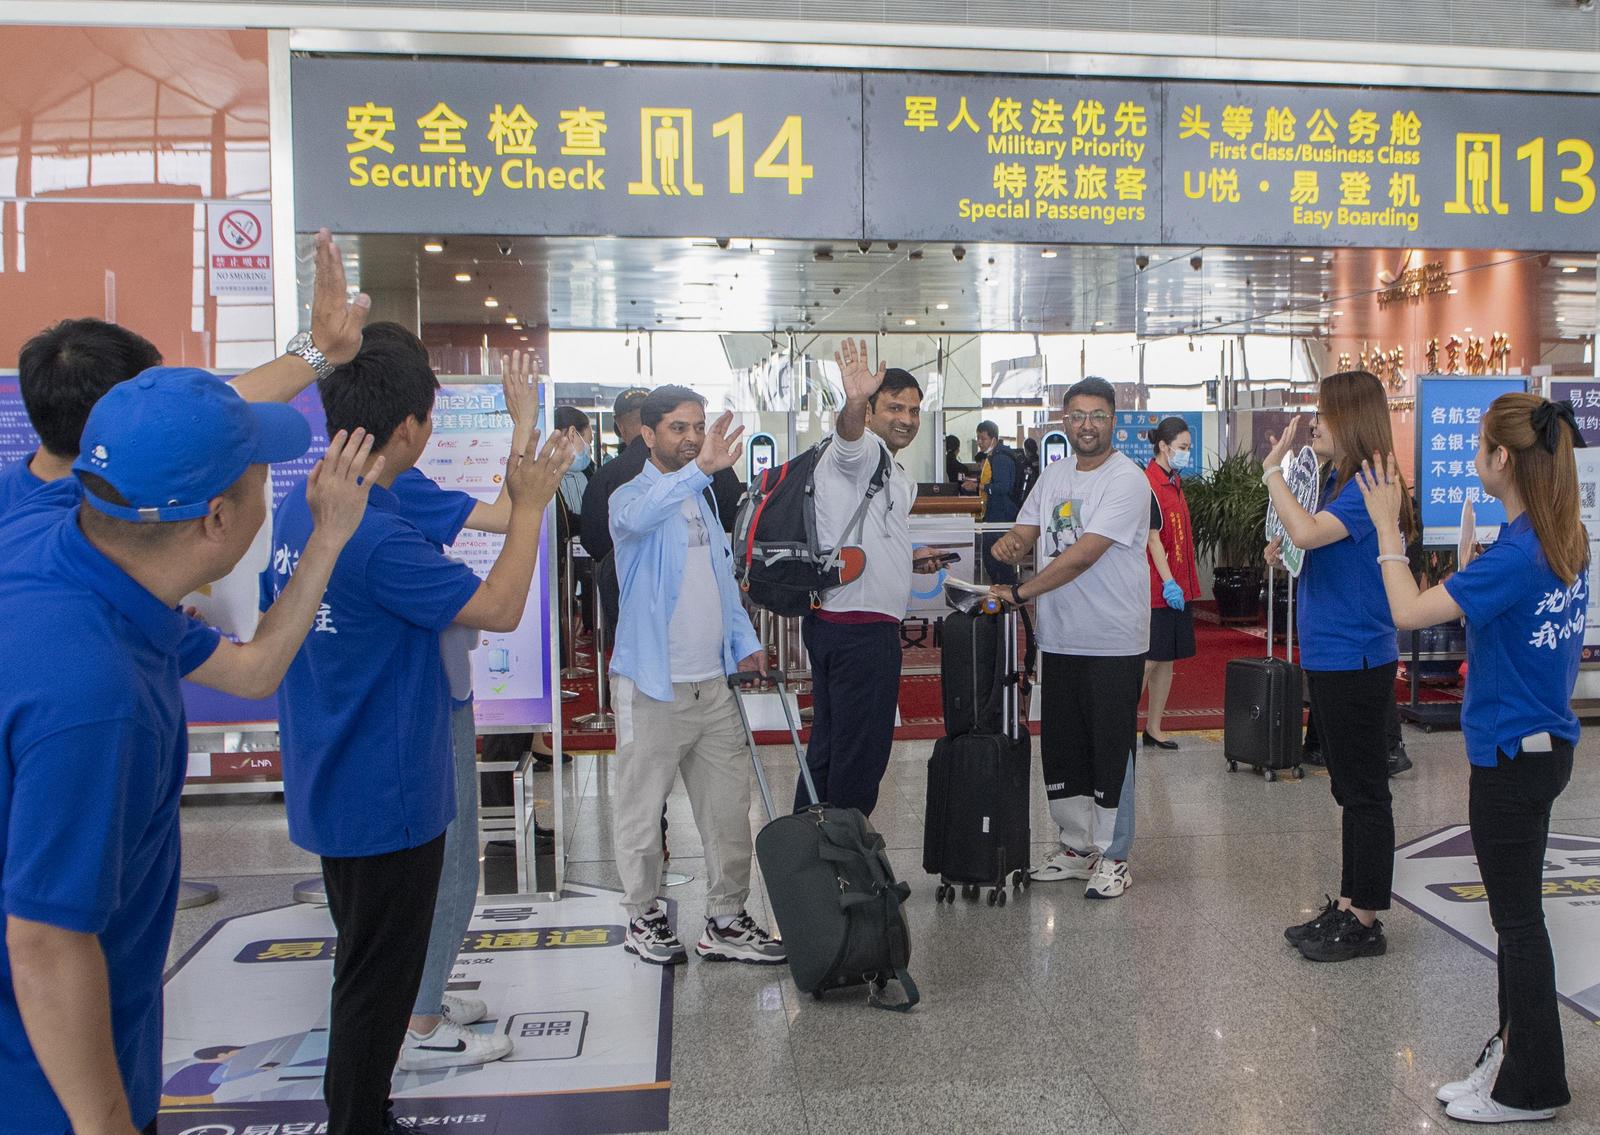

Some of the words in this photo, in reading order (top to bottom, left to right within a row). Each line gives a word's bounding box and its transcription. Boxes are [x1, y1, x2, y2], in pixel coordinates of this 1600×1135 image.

[346, 102, 608, 156] 安全检查
[904, 96, 1148, 138] 军人依法优先
[1178, 105, 1421, 147] 头等舱公务舱
[712, 112, 815, 195] 14
[987, 134, 1066, 158] Military
[1071, 137, 1146, 162] Priority
[1209, 141, 1247, 162] First
[1250, 143, 1375, 165] Class/Business
[1376, 145, 1421, 165] Class
[349, 156, 494, 197] Security
[500, 158, 606, 190] Check
[992, 162, 1148, 201] 特殊旅客
[1515, 137, 1598, 215] 13
[959, 197, 1030, 221] Special
[1035, 200, 1146, 225] Passengers
[1292, 205, 1333, 230] Easy
[1337, 206, 1420, 232] Boarding
[217, 272, 228, 280] NO
[229, 272, 267, 280] SMOKING
[1431, 406, 1490, 425] 各航空
